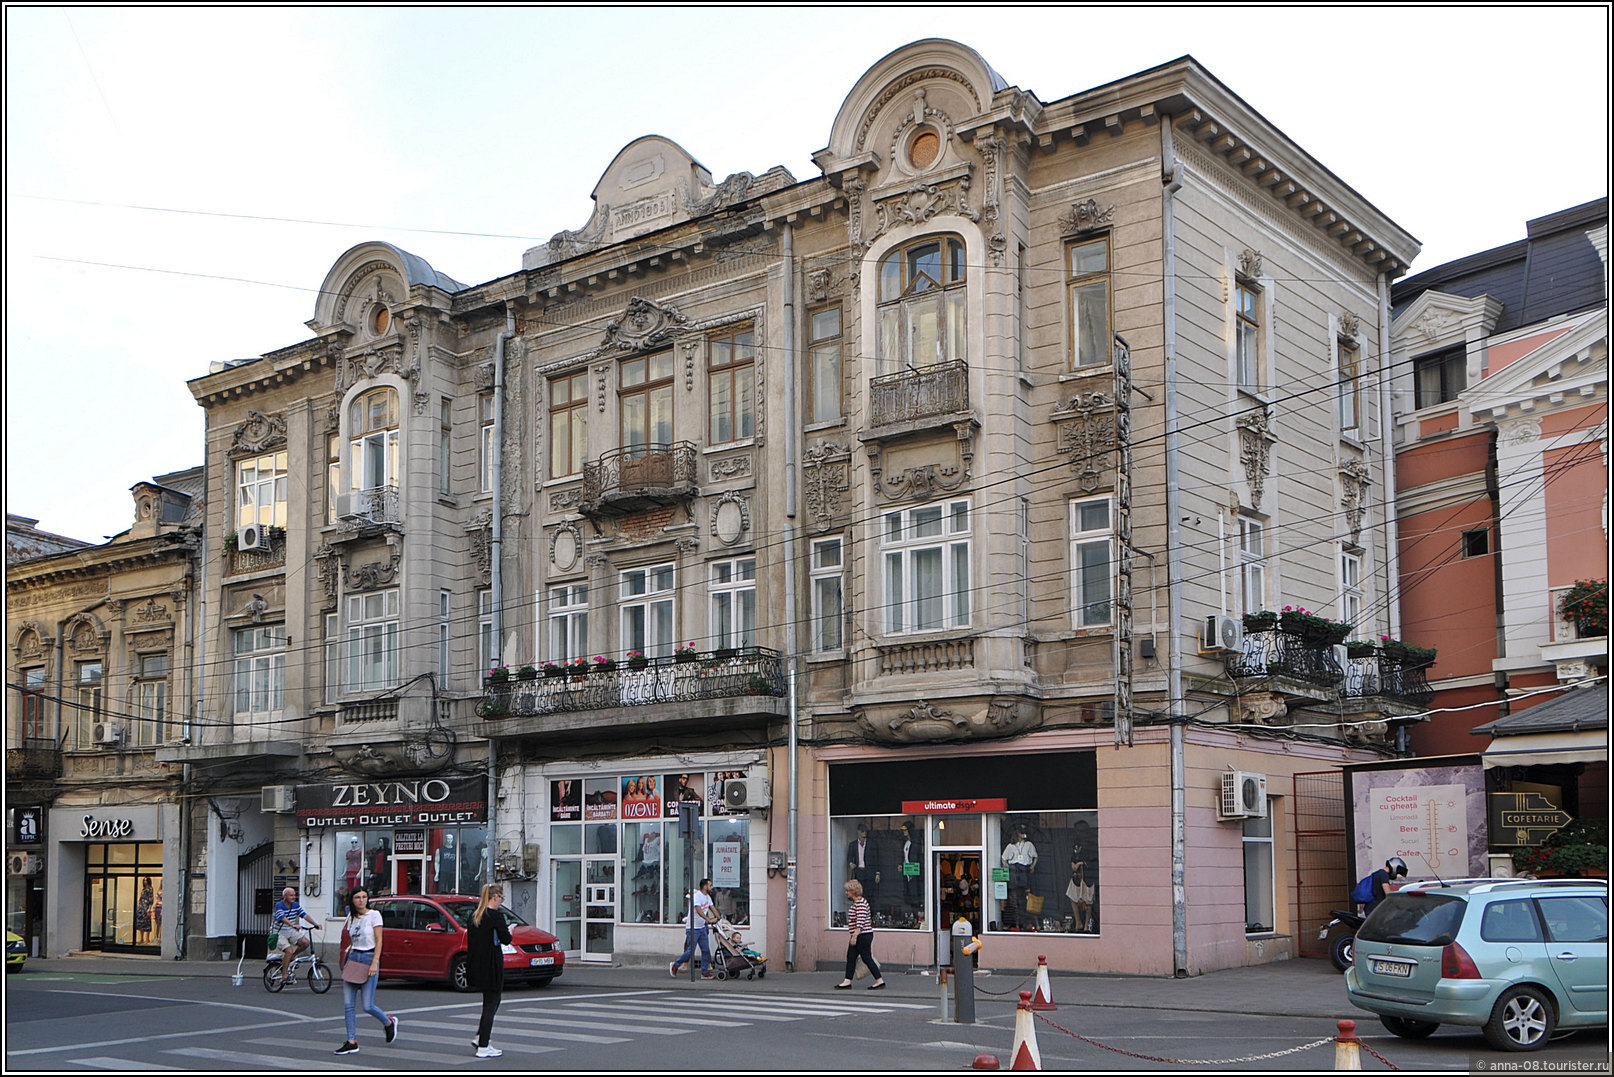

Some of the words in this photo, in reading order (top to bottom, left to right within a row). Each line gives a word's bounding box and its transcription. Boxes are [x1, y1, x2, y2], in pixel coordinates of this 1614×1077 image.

[615, 209, 640, 227] ANNO
[332, 779, 450, 807] ZEYNO
[1385, 795, 1418, 803] Cocktail
[624, 802, 658, 817] OZONE
[79, 814, 132, 838] Sense
[306, 817, 355, 827] OUTLET
[359, 815, 411, 825] OUTLET
[418, 812, 473, 822] OUTLET
[1506, 815, 1560, 823] COFETARIE
[1399, 825, 1419, 833] Bere
[1396, 849, 1420, 857] Cafea
